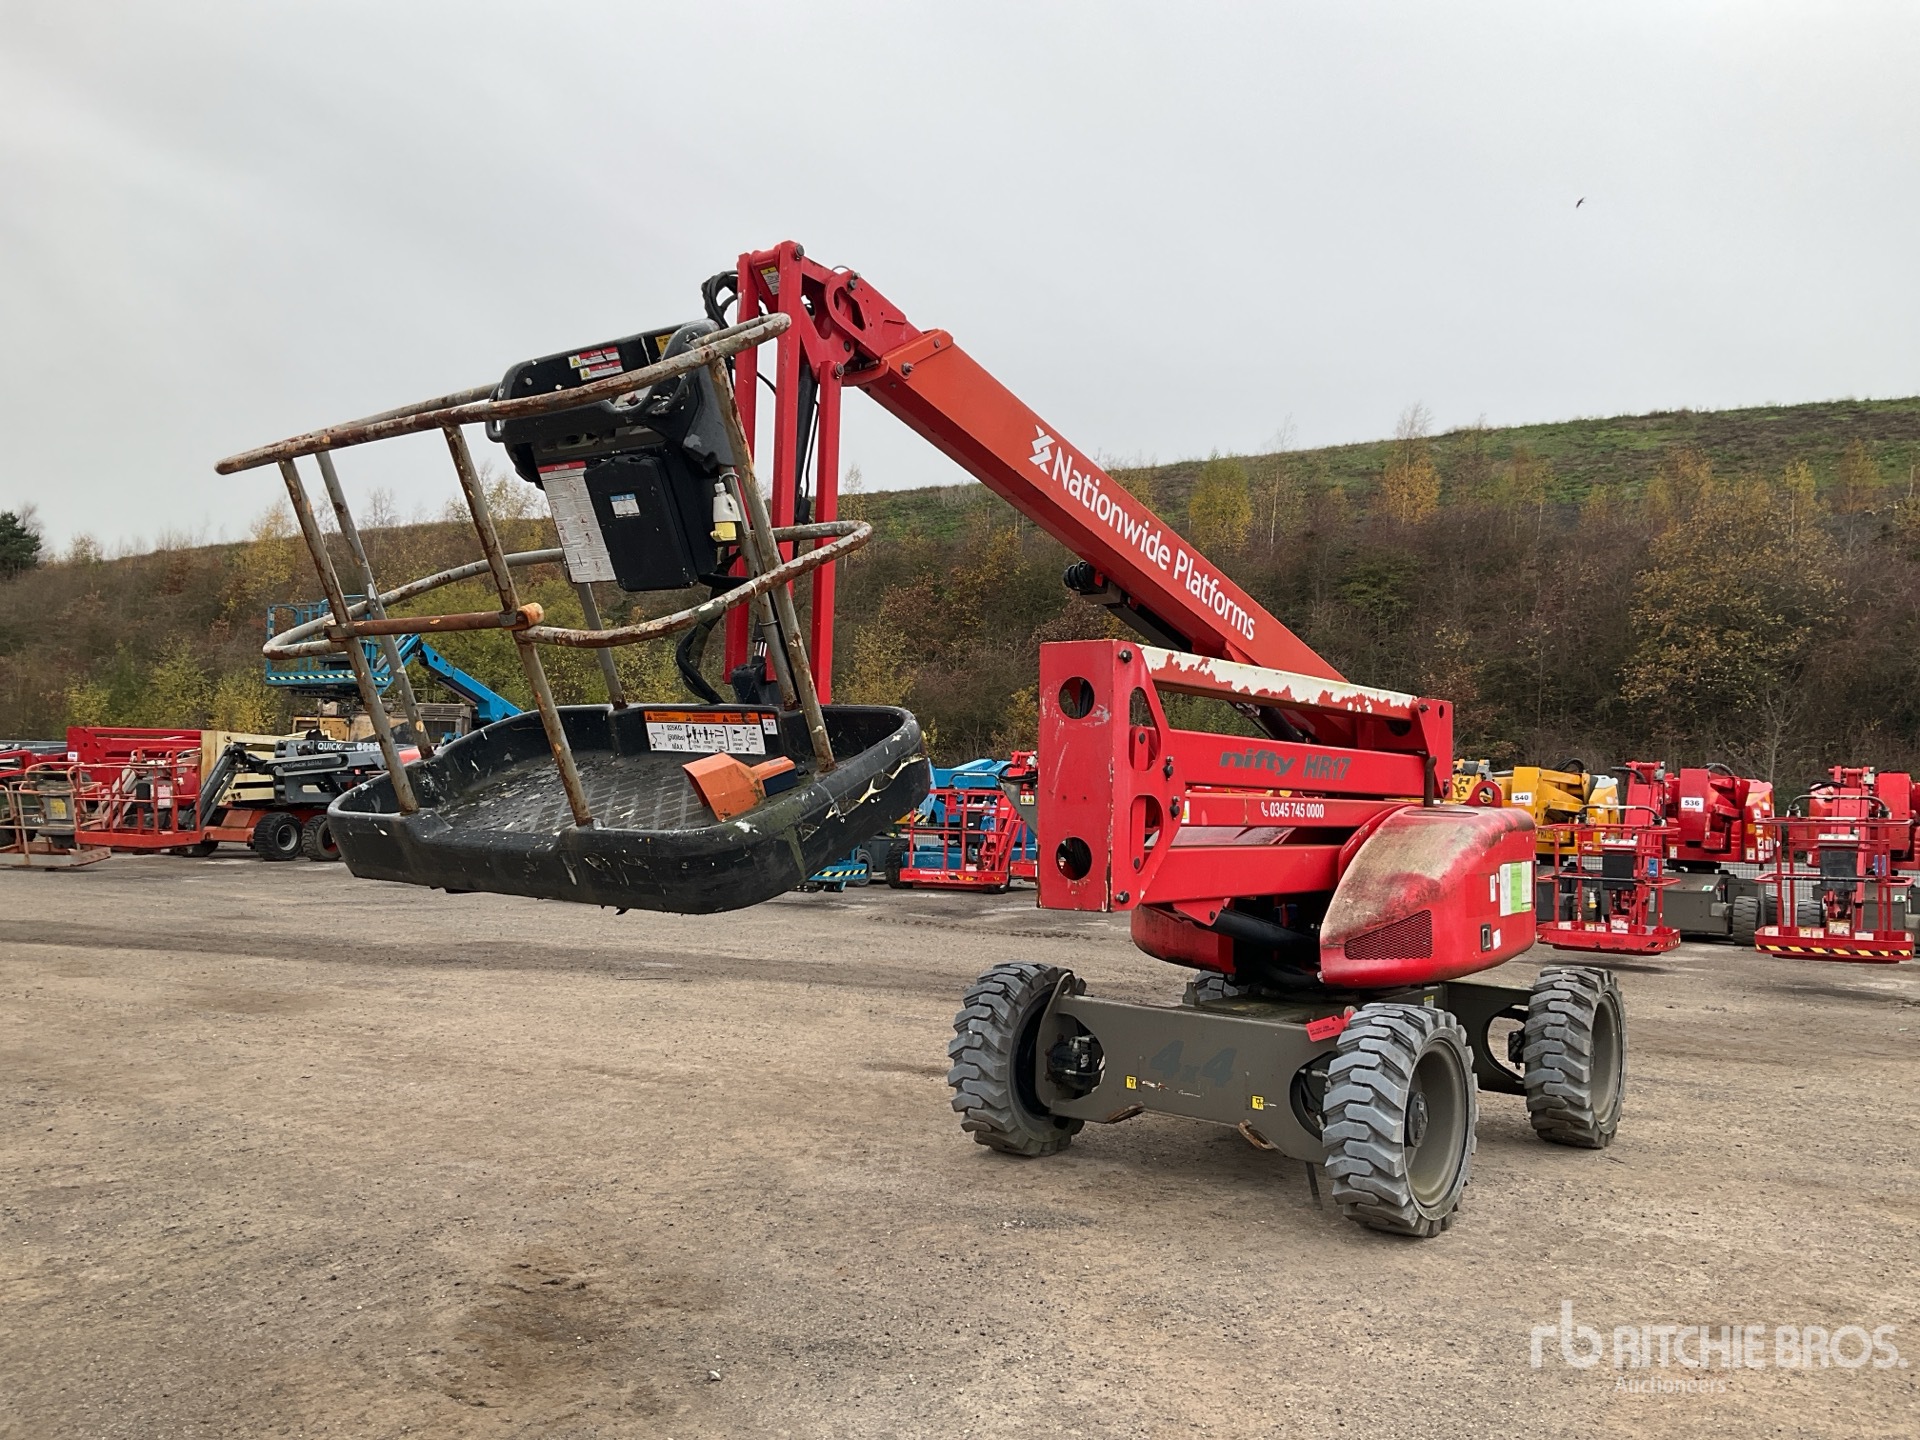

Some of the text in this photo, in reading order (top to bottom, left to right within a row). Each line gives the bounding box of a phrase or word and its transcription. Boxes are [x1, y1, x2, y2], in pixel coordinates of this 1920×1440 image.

[1052, 446, 1255, 641] Nationwide Platforms
[317, 742, 340, 751] QUICK
[1219, 748, 1352, 780] nifty HR17
[1269, 801, 1325, 818] 0345 745 0000
[1684, 799, 1700, 807] 536
